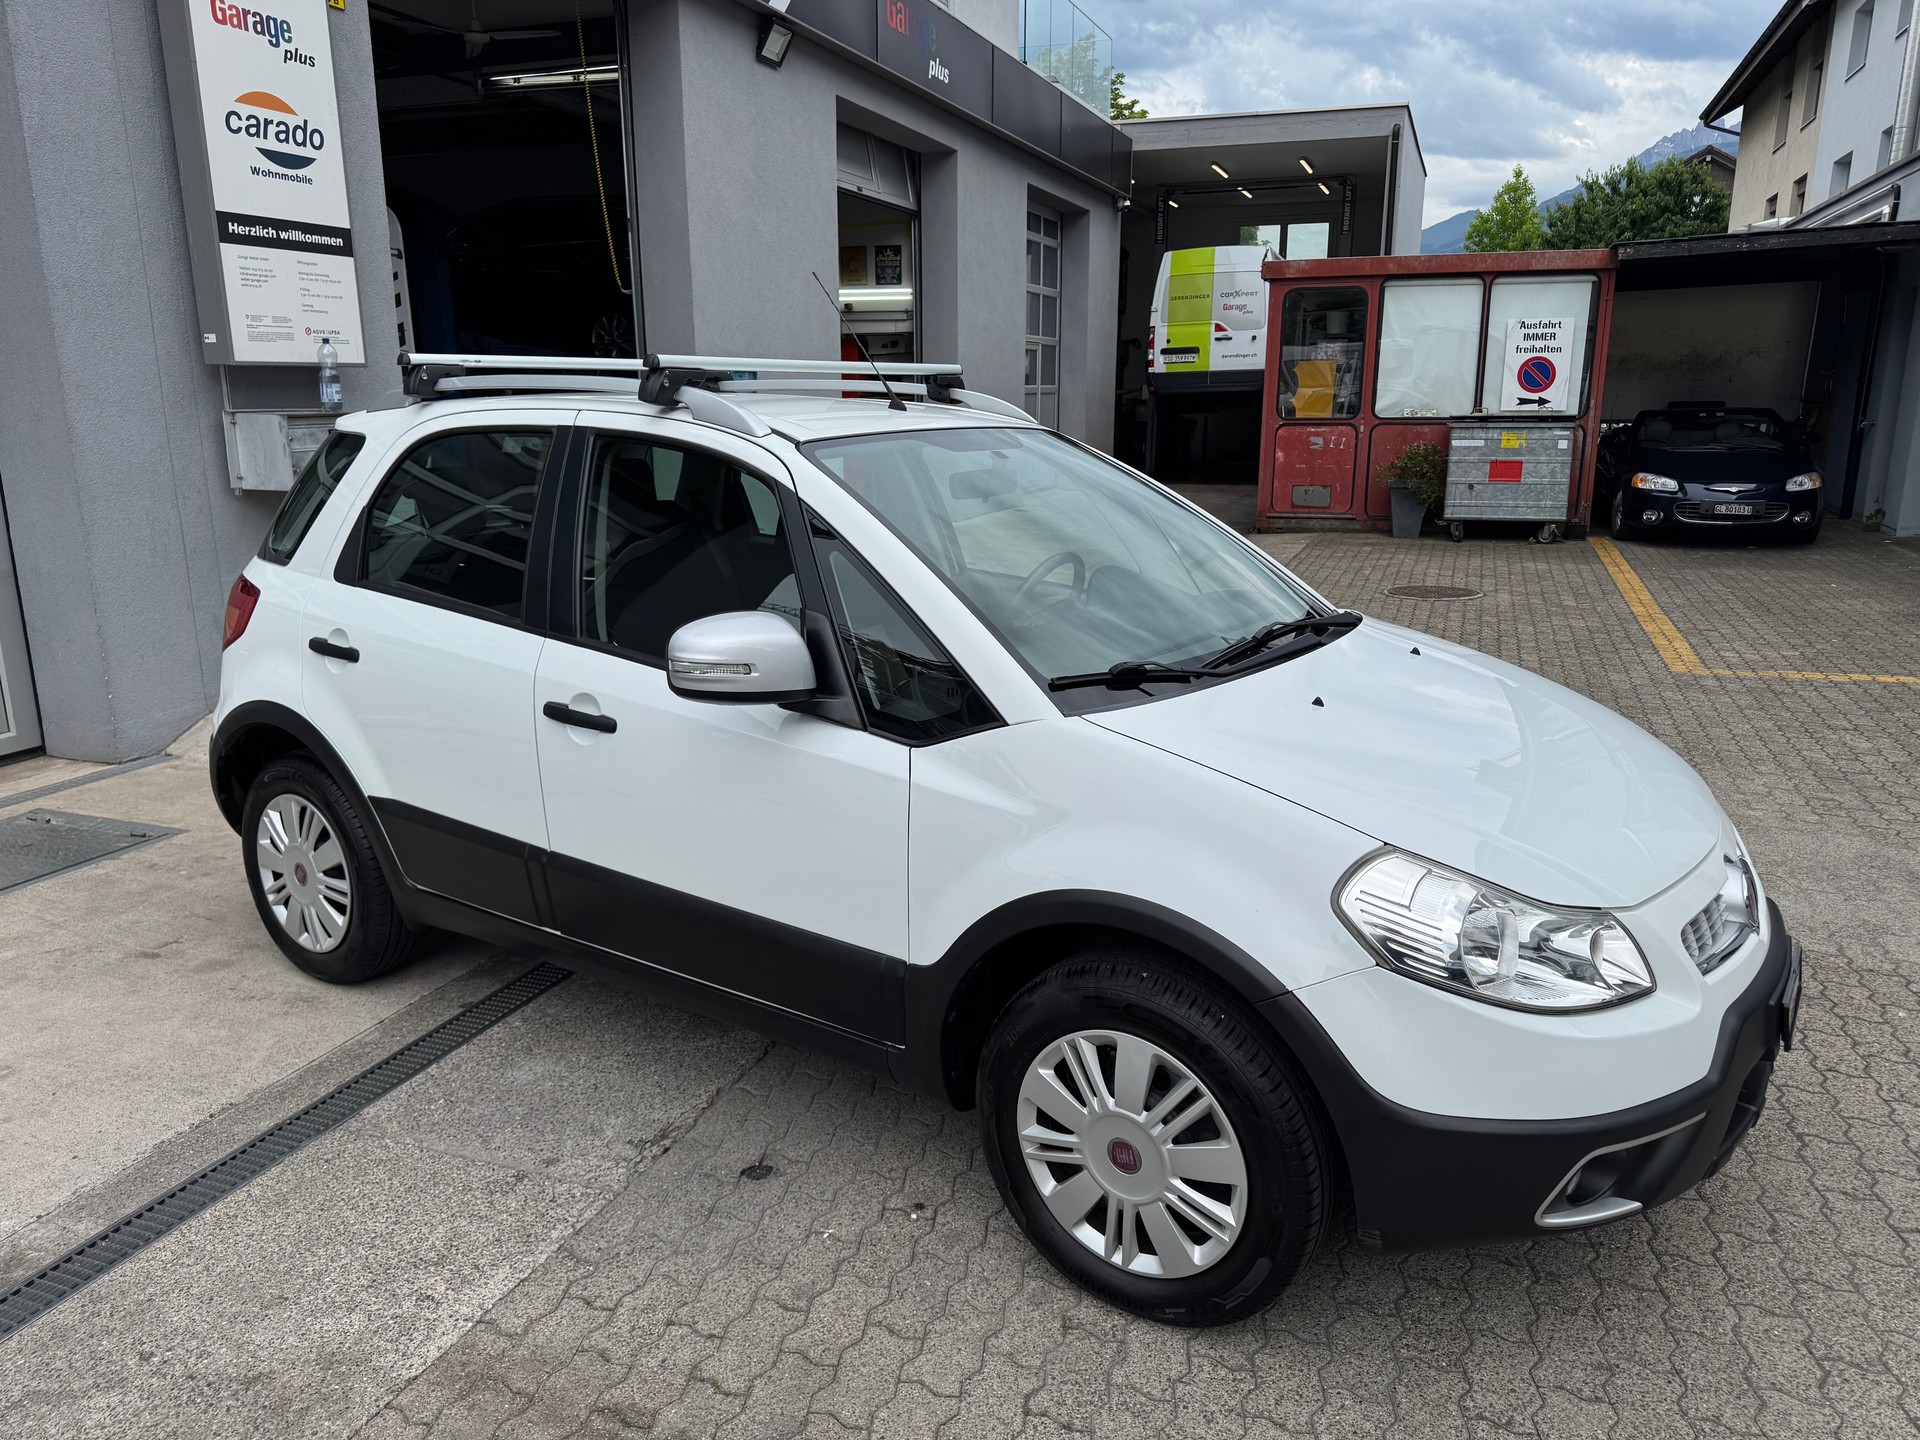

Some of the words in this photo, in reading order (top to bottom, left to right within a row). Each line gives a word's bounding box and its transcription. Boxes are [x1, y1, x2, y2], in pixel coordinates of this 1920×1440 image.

[209, 0, 293, 48] Garage
[886, 0, 937, 59] Garage
[283, 47, 316, 68] plus
[928, 57, 950, 84] plus
[224, 110, 325, 151] carado
[249, 165, 314, 185] Wohnmobile
[228, 221, 277, 239] Herzlich
[279, 229, 344, 247] willkommen
[1222, 303, 1248, 313] Garage
[1519, 320, 1562, 329] Ausfahrt
[1523, 332, 1556, 341] IMMER
[1515, 344, 1562, 353] freihalten
[1115, 1147, 1135, 1165] FIAT
